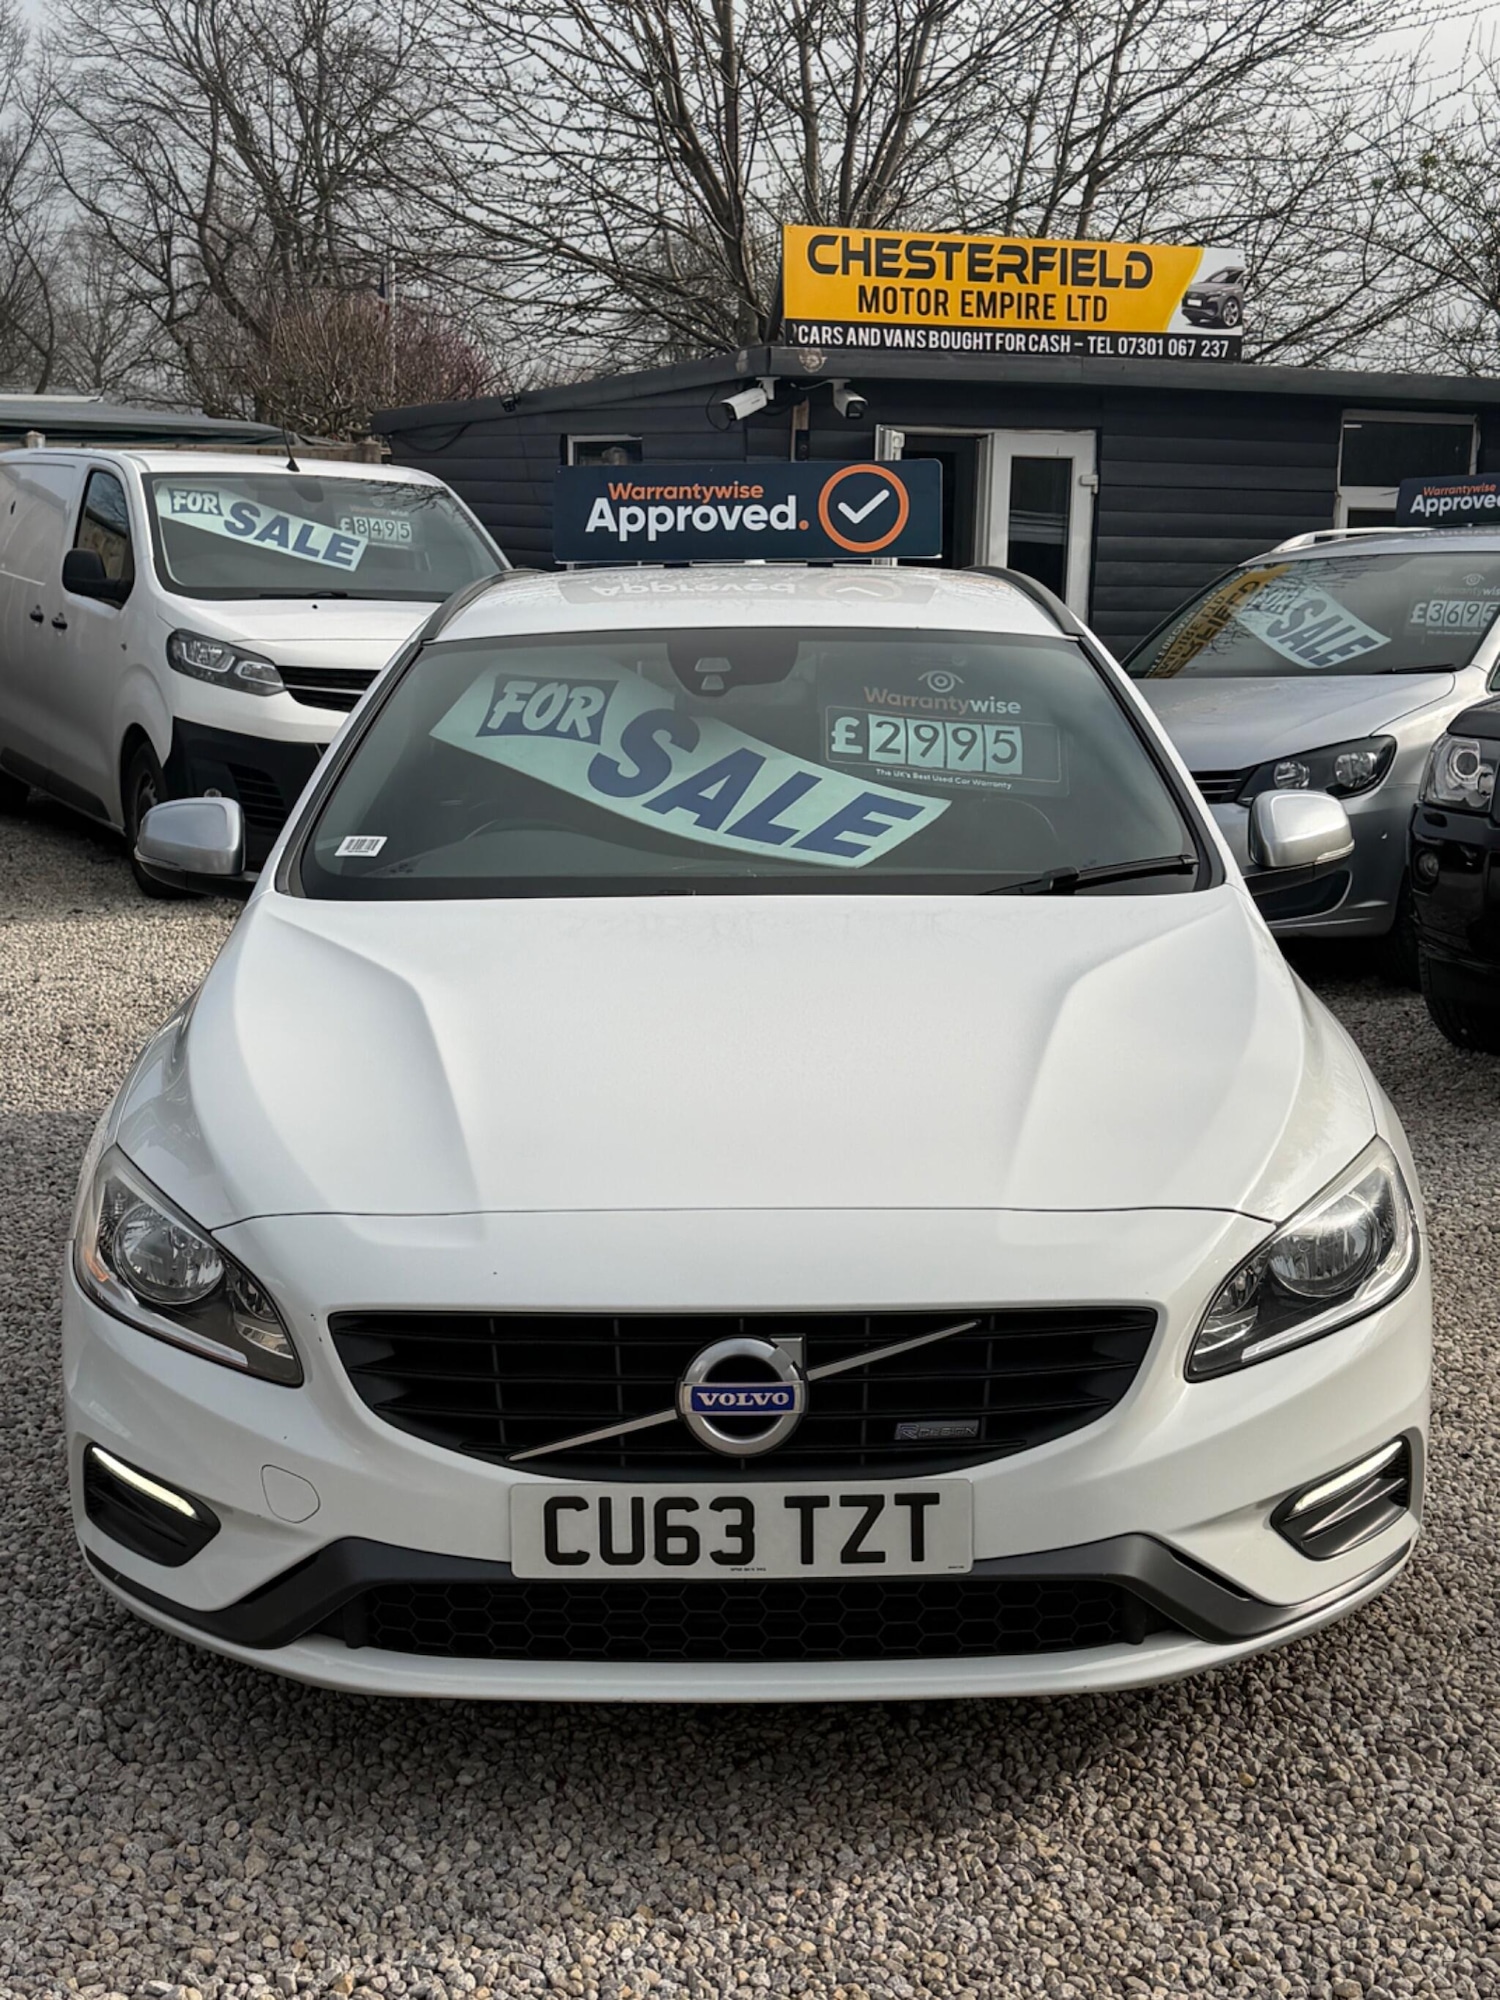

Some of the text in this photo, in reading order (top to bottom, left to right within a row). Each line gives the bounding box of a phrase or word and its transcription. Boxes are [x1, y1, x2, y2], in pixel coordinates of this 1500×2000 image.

[807, 234, 1153, 289] CHESTERFIELD
[858, 285, 1108, 322] MOTOR EMPIRE LTD
[798, 325, 844, 345] CARS
[846, 327, 881, 347] AND
[882, 329, 926, 348] VANS
[929, 330, 994, 351] BOUGHT
[995, 333, 1026, 351] FOR
[1028, 334, 1071, 353] CASH
[1087, 336, 1114, 354] TEL
[1118, 337, 1163, 356] 07301
[1168, 338, 1196, 357] 067
[1200, 339, 1229, 358] 237
[608, 481, 764, 504] Warrantywise
[1410, 494, 1500, 517] Approve
[1423, 482, 1497, 496] Warrantywise
[171, 490, 361, 566] FOR SALE
[340, 517, 410, 539] £8495
[585, 495, 809, 542] Approved.
[1410, 602, 1499, 624] £3695
[1266, 599, 1380, 667] SALE
[864, 686, 1021, 715] Warrantywise
[831, 716, 1018, 765] £2995
[485, 678, 927, 859] FOR SALE
[876, 768, 891, 777] The
[913, 772, 931, 781] Best
[932, 775, 953, 783] Used
[954, 777, 970, 785] Car
[972, 779, 1012, 790] Warranty
[696, 1392, 790, 1407] VOLVO
[543, 1492, 940, 1566] CU63 TZT
